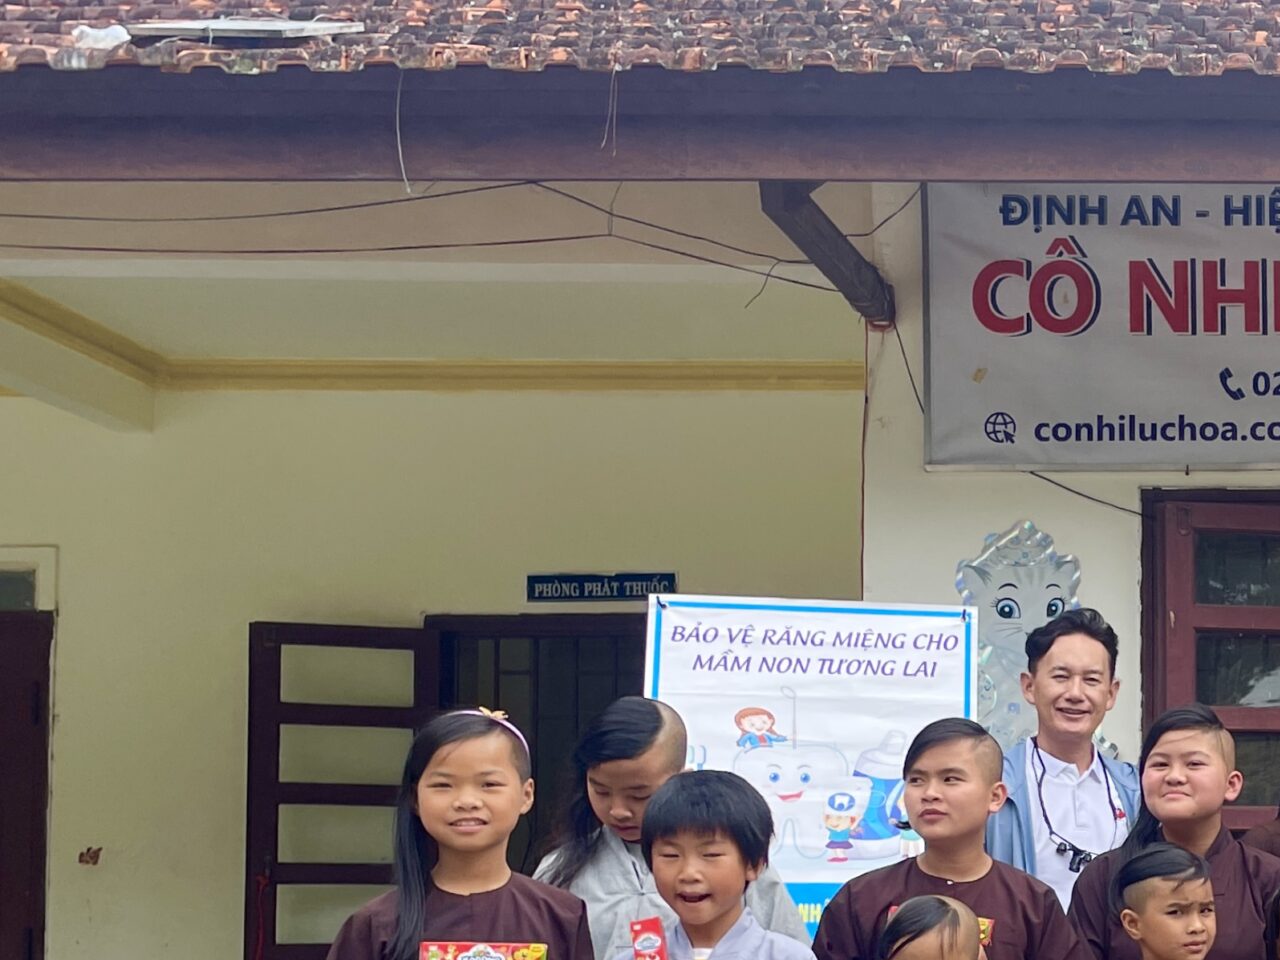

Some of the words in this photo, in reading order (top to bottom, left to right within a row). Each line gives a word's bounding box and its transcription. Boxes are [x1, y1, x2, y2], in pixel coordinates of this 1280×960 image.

[1000, 192, 1108, 233] ĐỊNH
[1121, 194, 1182, 227] AN
[972, 236, 1101, 337] CÔ
[534, 579, 579, 597] PHÒNG
[624, 576, 669, 595] THUỐC
[671, 622, 718, 644] BẢO
[728, 624, 755, 648] VỆ
[761, 626, 826, 648] RĂNG
[832, 628, 905, 653] MIỆNG
[913, 632, 958, 651] CHO
[692, 649, 750, 673] MẦM
[758, 656, 810, 674] NON
[818, 657, 896, 677] TƯƠNG
[903, 661, 937, 677] LAI
